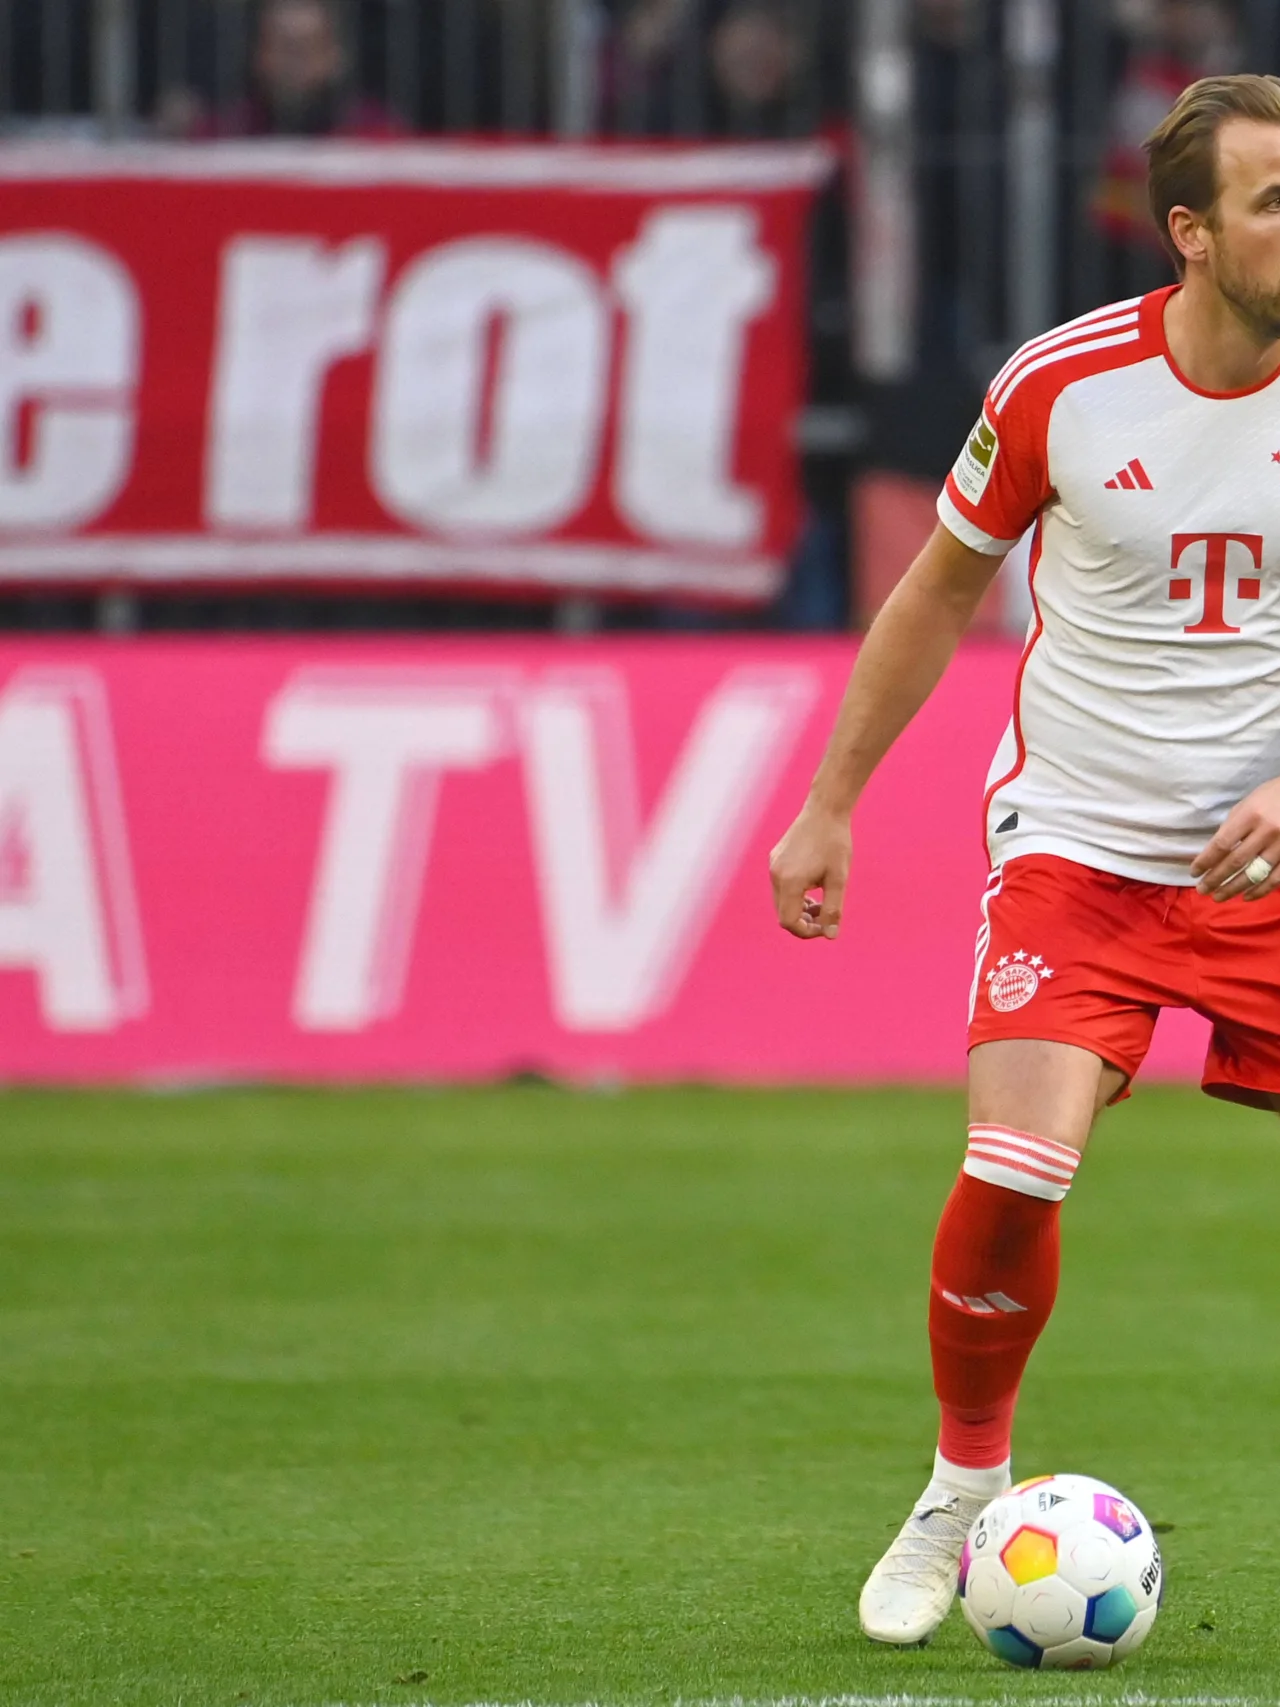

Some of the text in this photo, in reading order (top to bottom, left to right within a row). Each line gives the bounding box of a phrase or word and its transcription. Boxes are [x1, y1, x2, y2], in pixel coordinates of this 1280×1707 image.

[205, 206, 778, 547] rot
[1169, 533, 1263, 634] T
[260, 665, 820, 1030] TV
[1141, 1545, 1162, 1596] STAR
